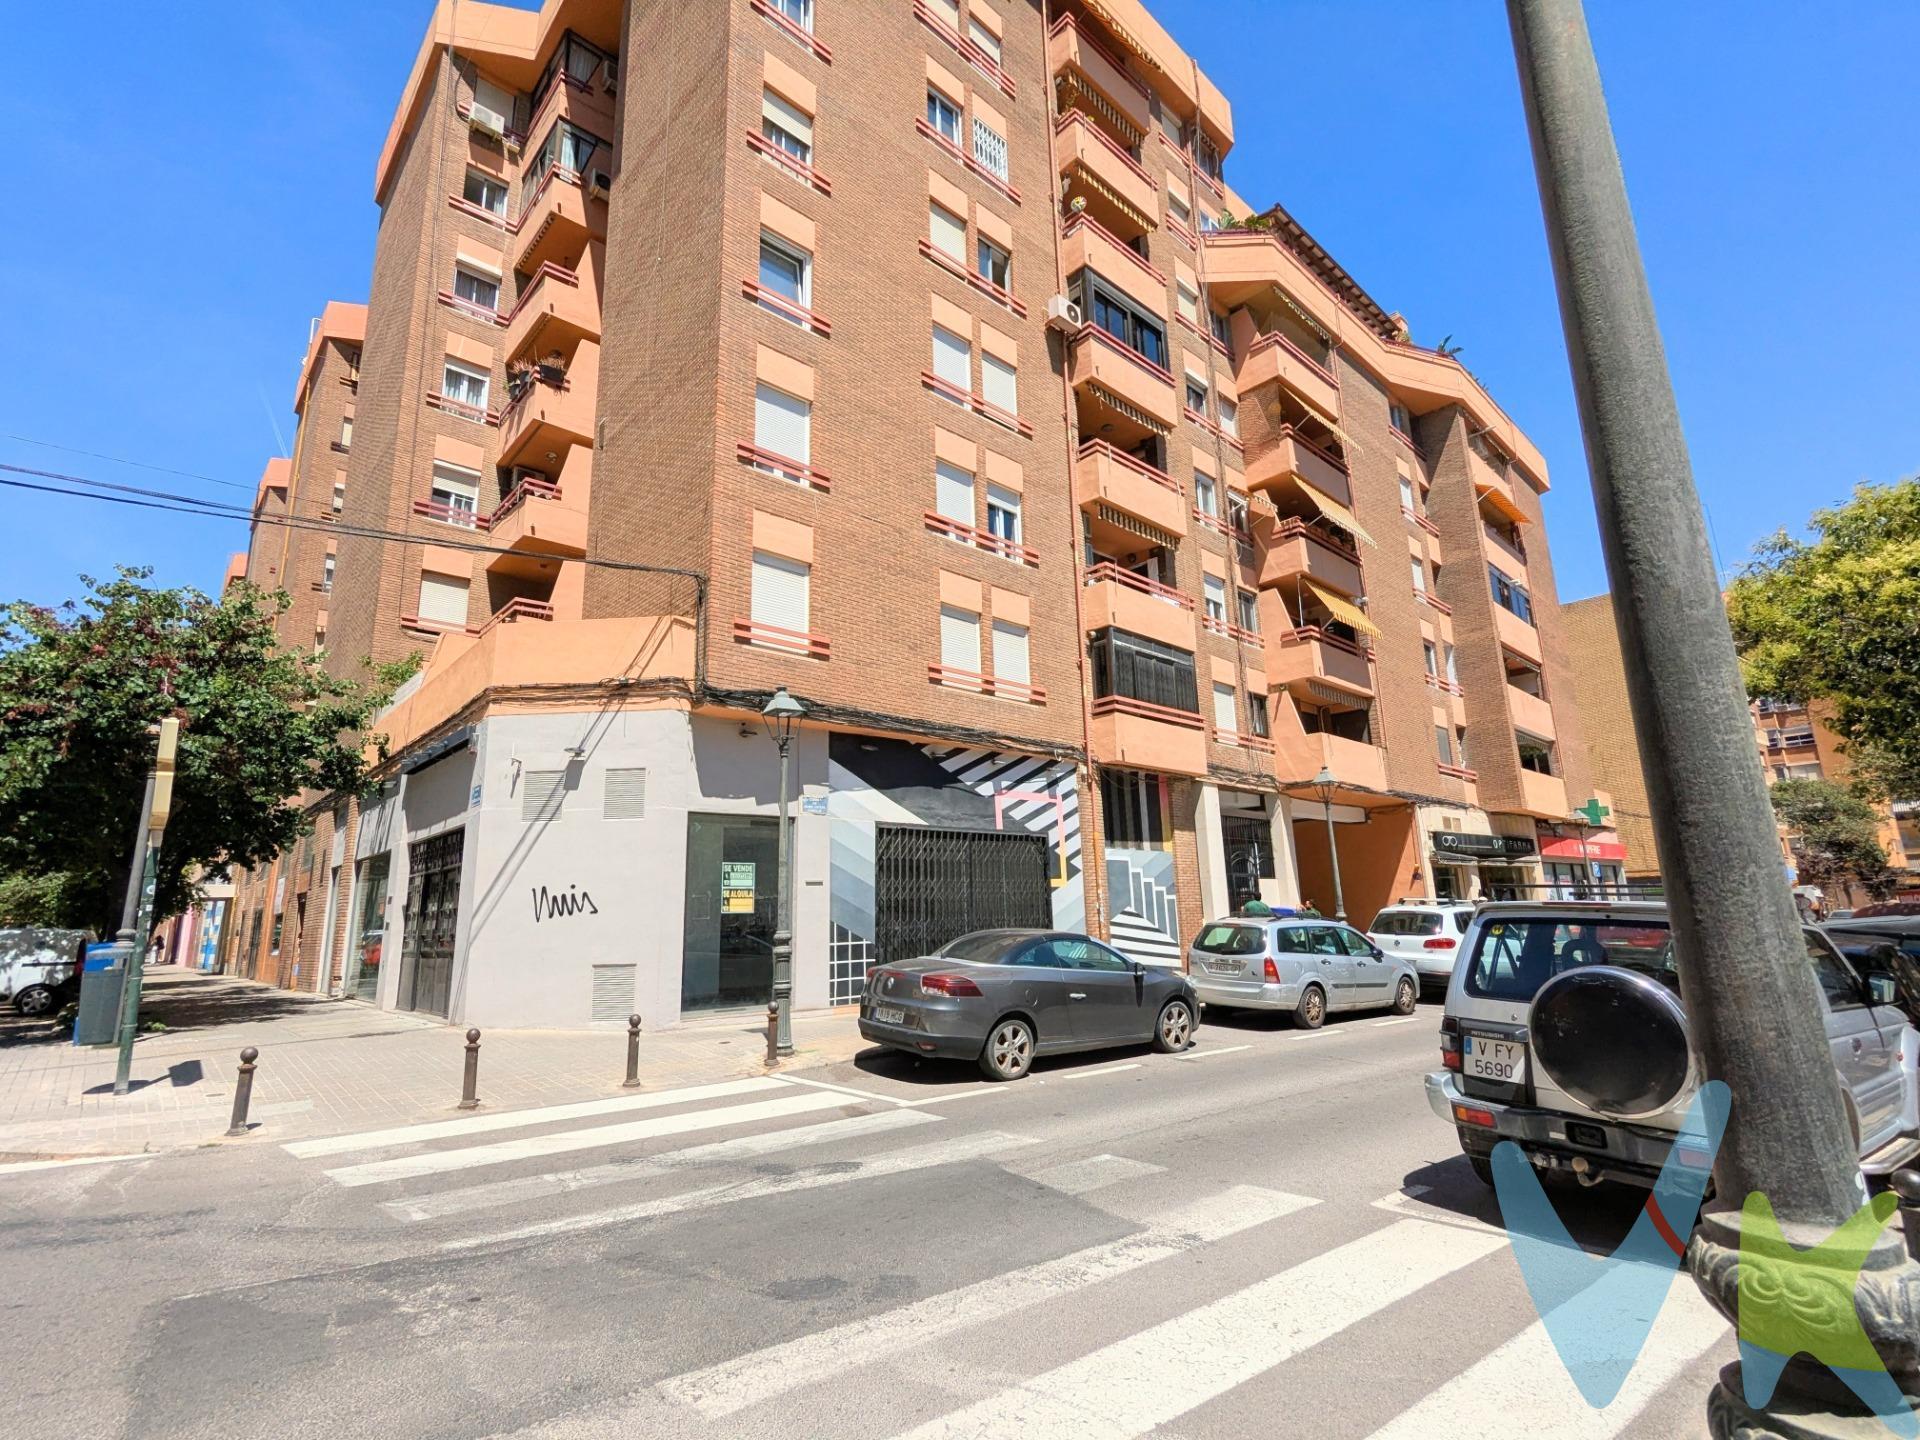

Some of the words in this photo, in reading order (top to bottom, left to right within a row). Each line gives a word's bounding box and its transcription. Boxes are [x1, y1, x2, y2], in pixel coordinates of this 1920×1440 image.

[724, 864, 731, 872] SE
[733, 864, 752, 872] VENDE
[724, 889, 730, 898] SE
[731, 889, 752, 898] ALQUILA
[1479, 1041, 1487, 1056] V
[1495, 1043, 1514, 1059] FY
[1475, 1060, 1513, 1078] 5690
